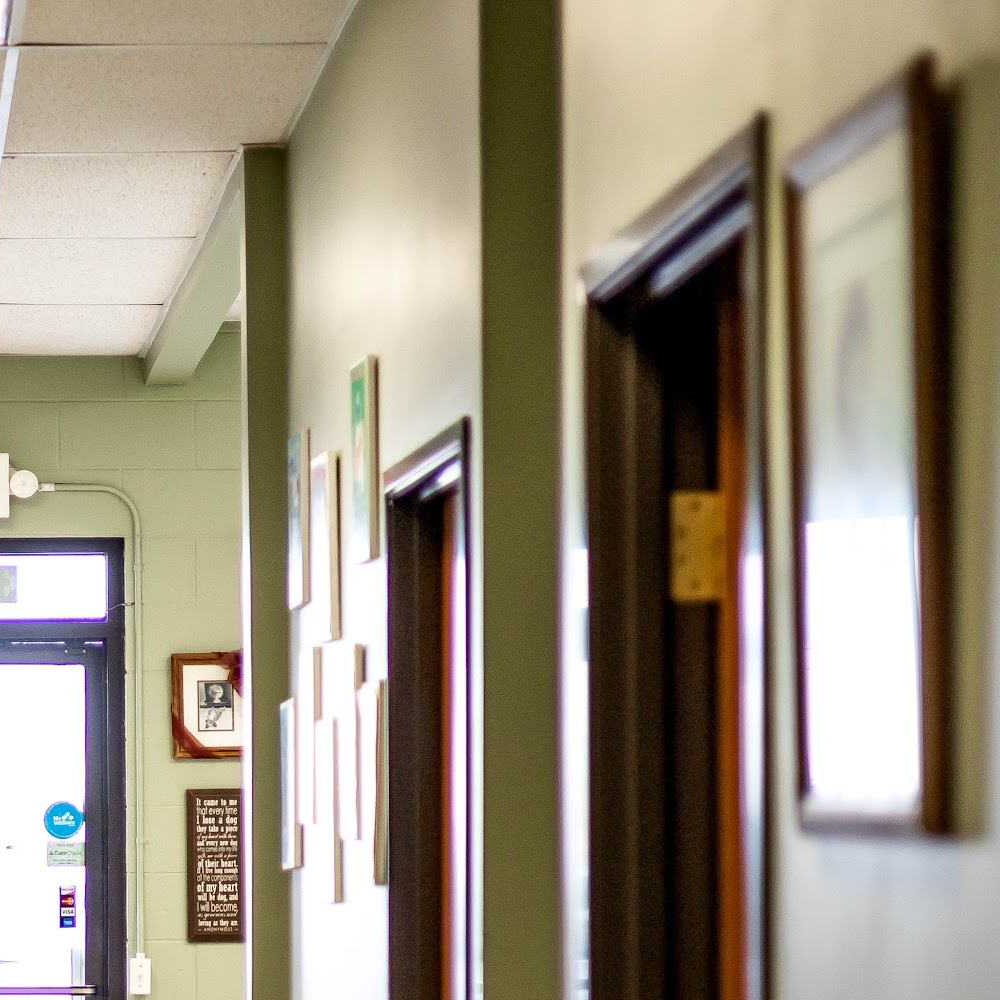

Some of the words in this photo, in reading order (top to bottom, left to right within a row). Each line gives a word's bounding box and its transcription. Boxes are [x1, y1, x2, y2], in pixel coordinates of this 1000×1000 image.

[196, 798, 201, 806] It
[221, 798, 227, 806] to
[196, 806, 208, 815] that
[209, 807, 224, 816] every
[225, 806, 238, 815] time
[203, 815, 215, 824] lose
[226, 815, 238, 825] dog
[197, 825, 207, 834] they
[226, 825, 238, 834] piece
[230, 839, 238, 847] dog
[198, 859, 204, 867] of
[205, 859, 220, 867] their
[211, 874, 238, 882] components
[197, 881, 205, 892] of
[206, 884, 217, 894] my
[219, 881, 238, 892] heart
[197, 893, 207, 901] will
[209, 893, 215, 901] be
[229, 893, 238, 901] and
[200, 902, 210, 912] will
[198, 919, 211, 927] loving
[219, 919, 229, 927] they
